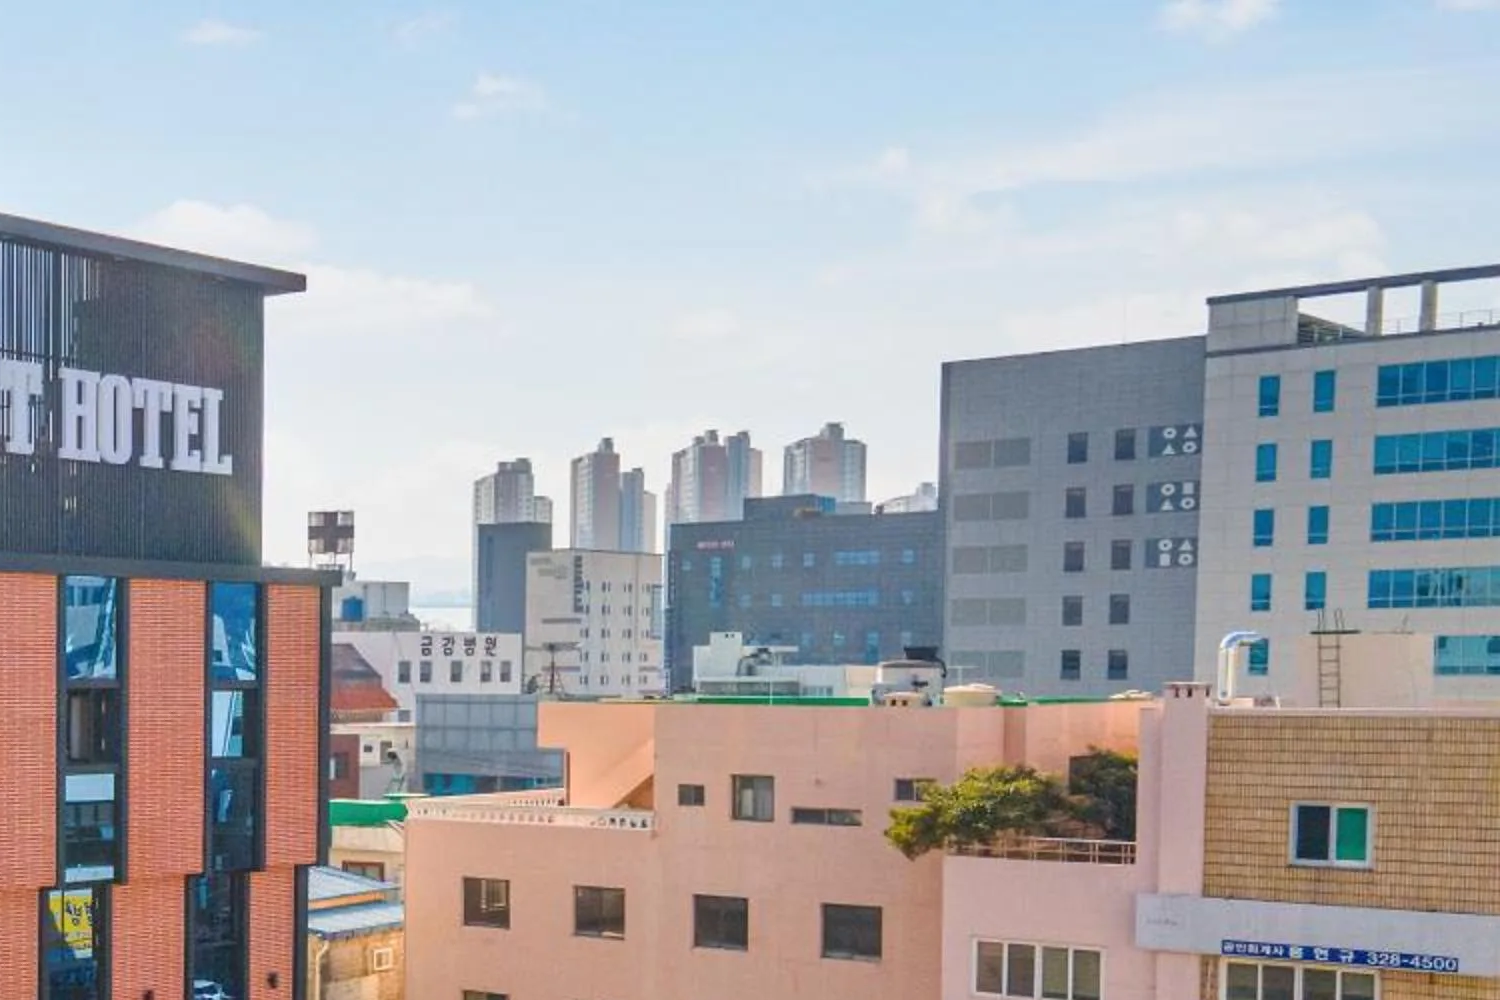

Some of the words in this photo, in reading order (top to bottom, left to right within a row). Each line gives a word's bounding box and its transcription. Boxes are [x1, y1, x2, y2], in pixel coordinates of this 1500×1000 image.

[56, 366, 233, 475] HOTEL
[420, 635, 498, 657] 금강병원
[1367, 953, 1458, 972] 328-4500
